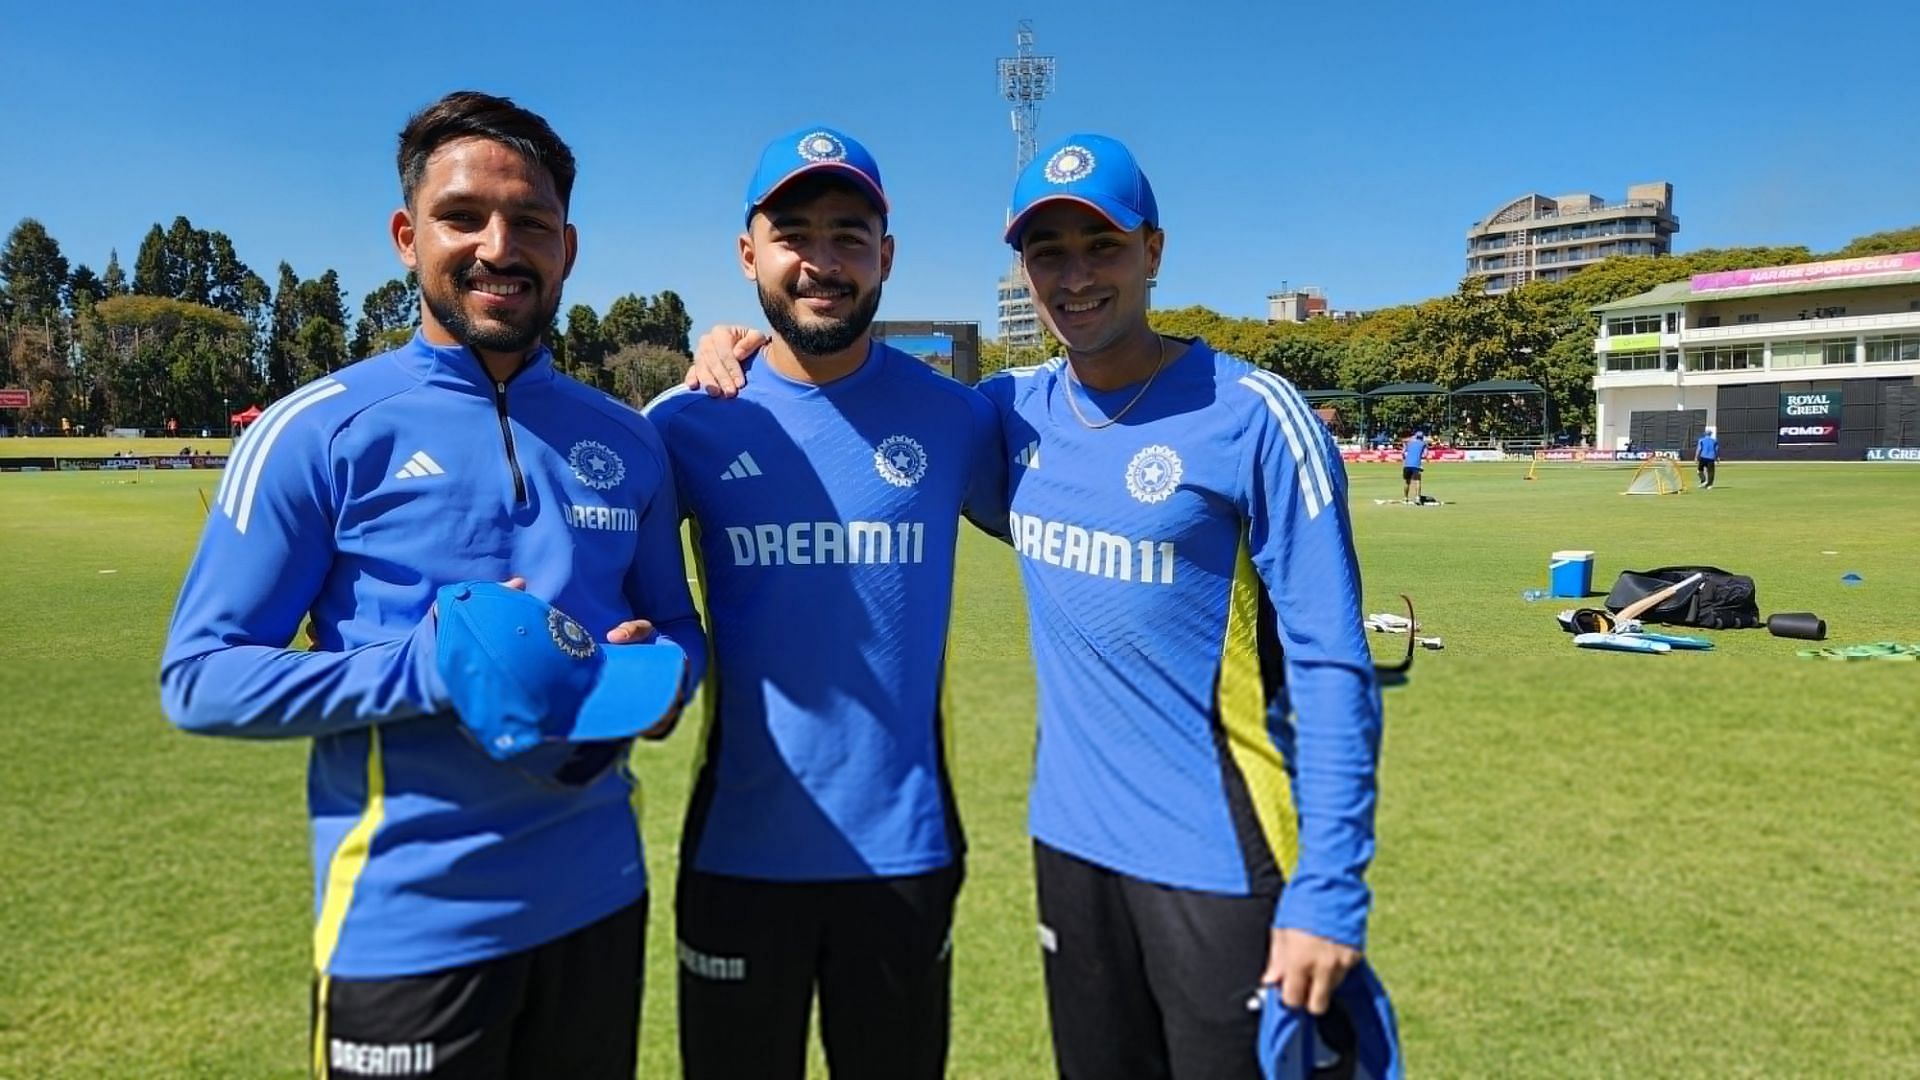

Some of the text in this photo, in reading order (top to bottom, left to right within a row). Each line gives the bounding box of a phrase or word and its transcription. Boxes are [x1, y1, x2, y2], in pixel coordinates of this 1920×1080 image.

[1750, 258, 1904, 281] HARARE SPORTS CLUB
[1787, 394, 1831, 405] ROYAL
[1786, 405, 1829, 416] GREEN
[1780, 426, 1834, 436] FOMO7
